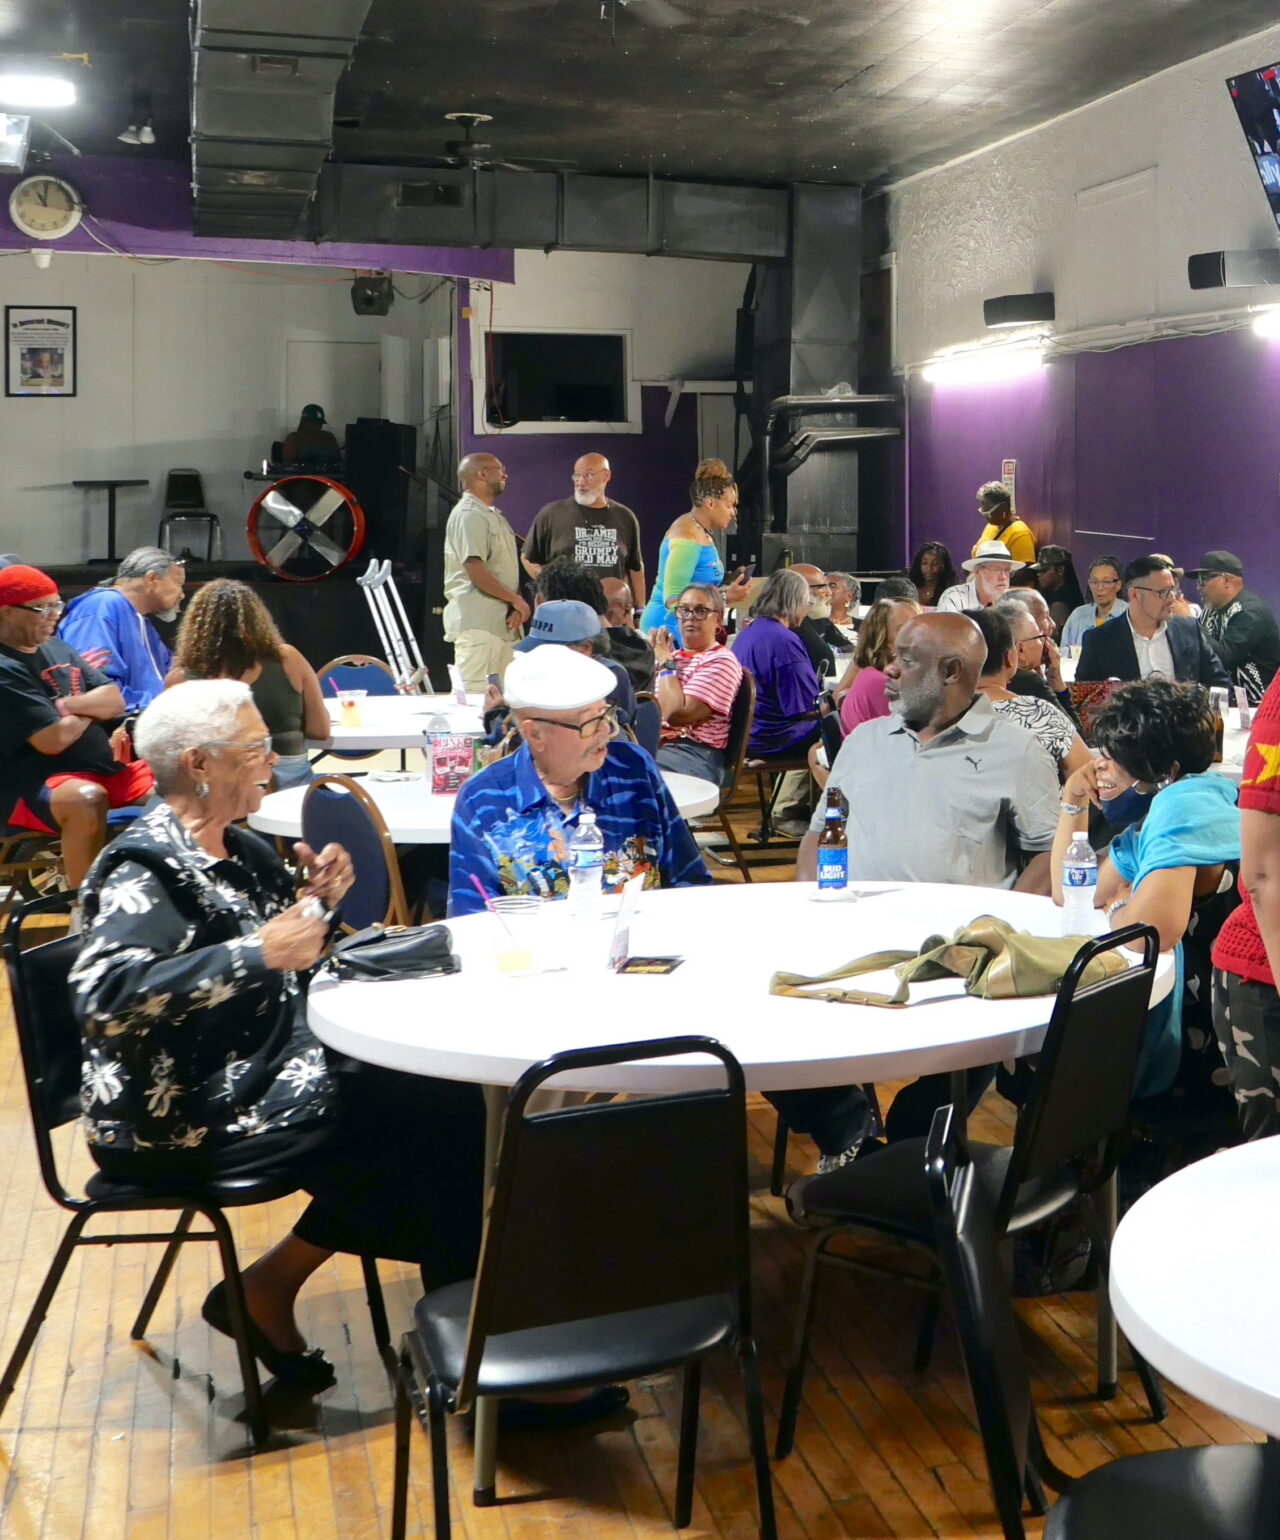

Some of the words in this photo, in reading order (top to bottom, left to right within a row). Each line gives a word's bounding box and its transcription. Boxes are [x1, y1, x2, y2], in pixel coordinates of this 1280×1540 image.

[575, 545, 618, 556] GRUMPY
[575, 555, 593, 564] OLD
[596, 555, 619, 565] MAN
[822, 864, 843, 872] BUD
[820, 871, 846, 880] LIGHT
